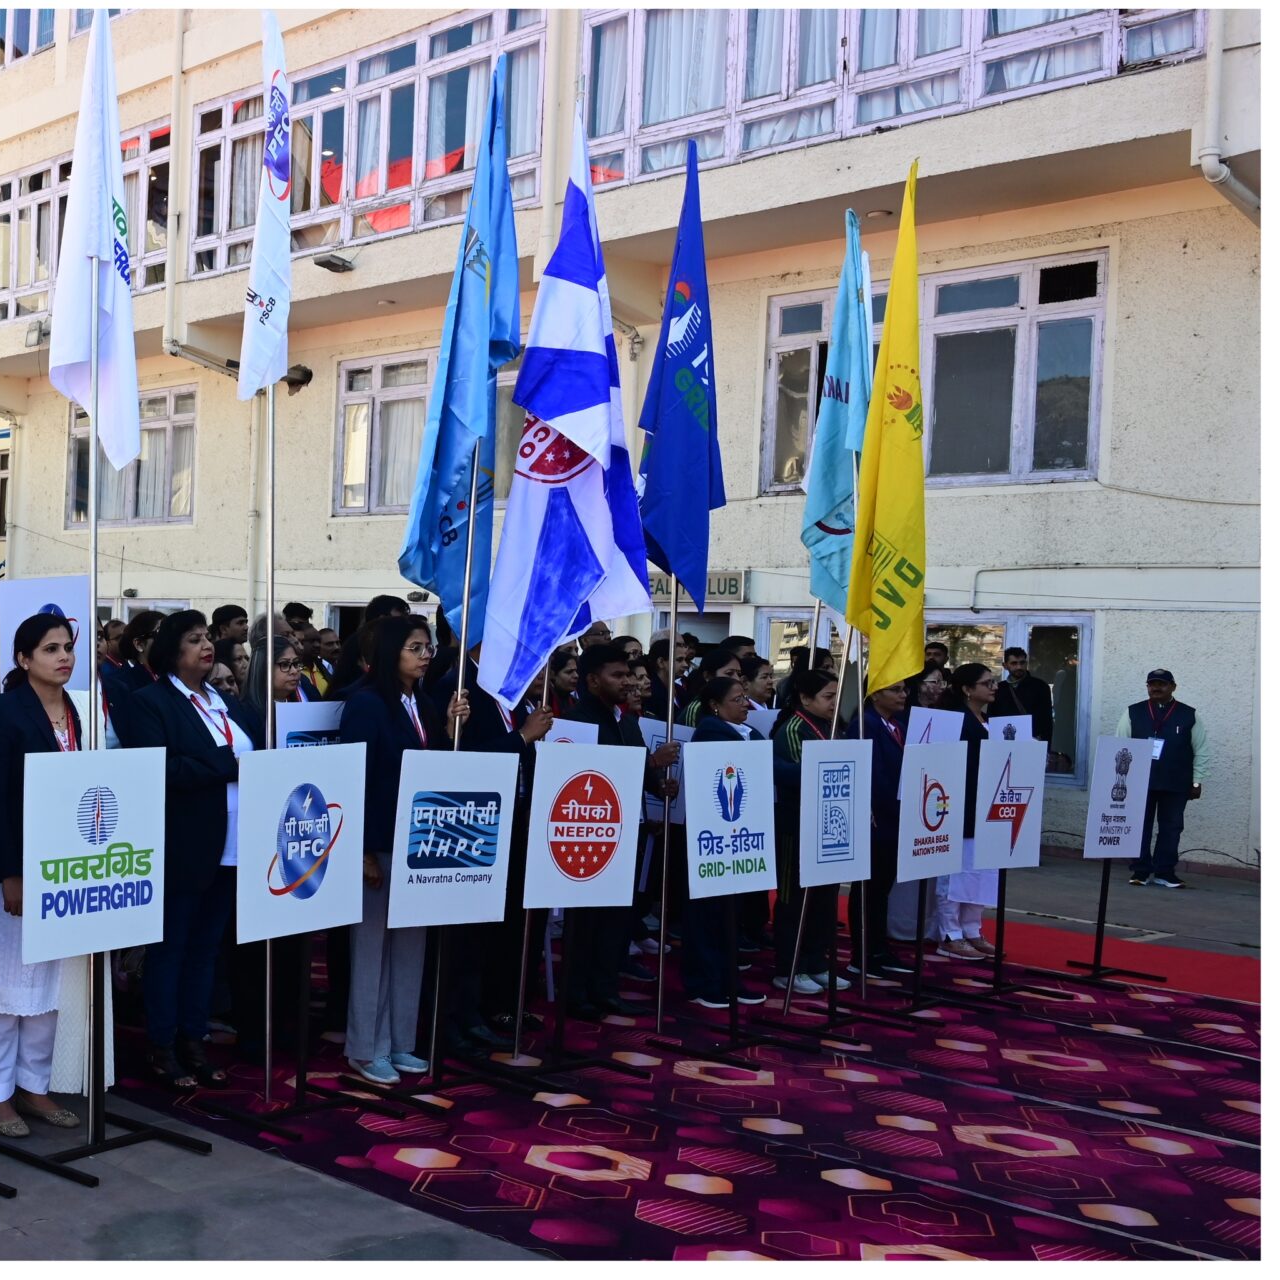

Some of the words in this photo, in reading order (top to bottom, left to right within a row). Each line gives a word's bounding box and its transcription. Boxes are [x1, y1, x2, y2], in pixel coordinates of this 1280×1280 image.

[708, 578, 738, 595] LUB
[822, 784, 850, 799] DVC
[561, 799, 612, 820] नीपको
[999, 806, 1017, 818] cea
[285, 817, 297, 837] पी
[315, 814, 328, 833] सी
[554, 826, 616, 838] NEEPCO
[1100, 825, 1124, 835] MINISTRY
[1124, 825, 1132, 835] OF
[417, 834, 485, 858] NHPC
[697, 827, 765, 856] ग्रिड-इंडिया
[914, 835, 934, 847] BHAKRA
[935, 834, 949, 844] BEAS
[935, 844, 950, 854] PRIDE
[1098, 836, 1121, 846] POWER
[287, 839, 325, 860] PFC
[40, 842, 154, 884] पावरग्रिड
[698, 857, 767, 879] GRID-INDIA
[407, 874, 414, 884] A
[416, 873, 453, 884] Navratna
[455, 872, 492, 884] Company
[41, 879, 153, 920] POWERGRID
